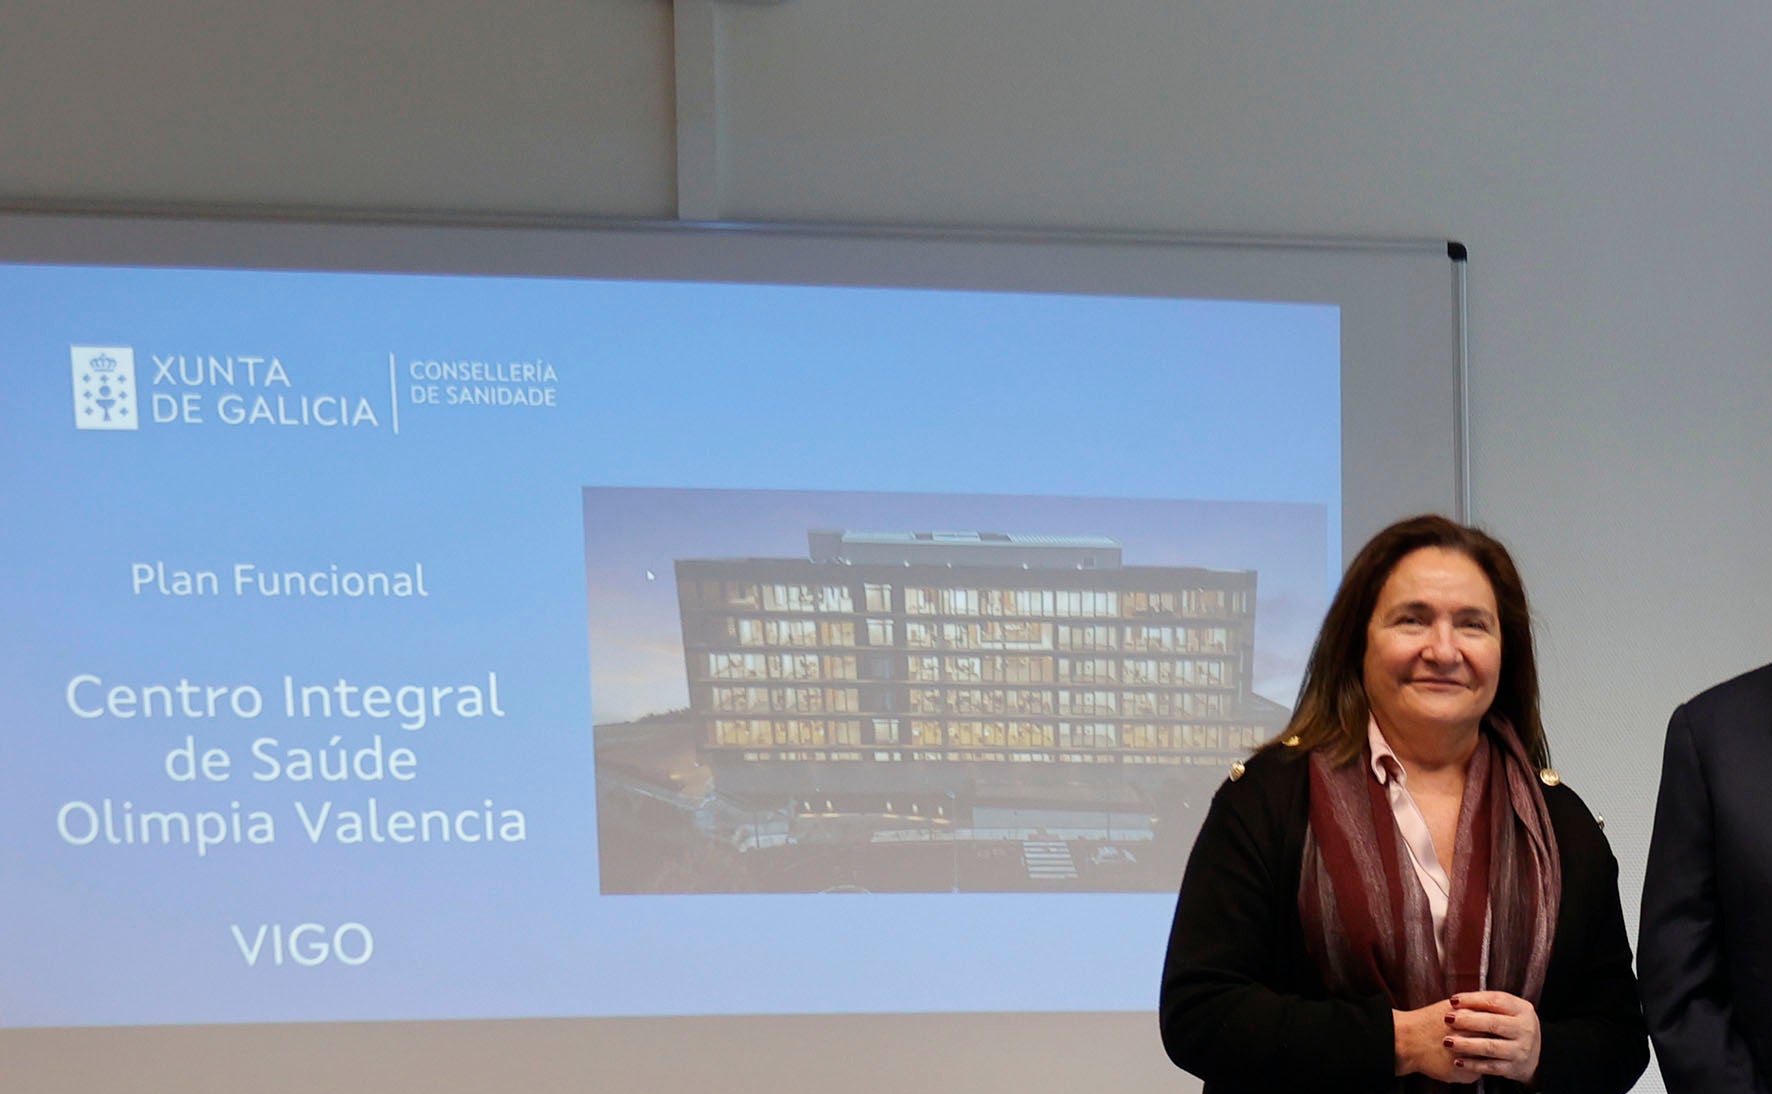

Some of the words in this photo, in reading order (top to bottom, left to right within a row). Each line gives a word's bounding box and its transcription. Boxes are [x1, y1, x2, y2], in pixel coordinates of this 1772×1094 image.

[152, 355, 291, 387] XUNTA
[409, 359, 558, 383] CONSELLERÍA
[152, 392, 203, 424] DE
[217, 393, 379, 427] GALICIA
[410, 384, 438, 405] DE
[446, 385, 556, 407] SANIDADE
[132, 561, 219, 596] Plan
[234, 563, 429, 597] Funcional
[66, 674, 263, 719] Centro
[284, 671, 505, 731] Integral
[165, 735, 231, 782] de
[251, 734, 417, 782] Saúde
[57, 798, 275, 857] Olimpia
[294, 797, 526, 844] Valencia
[231, 922, 374, 966] VIGO
